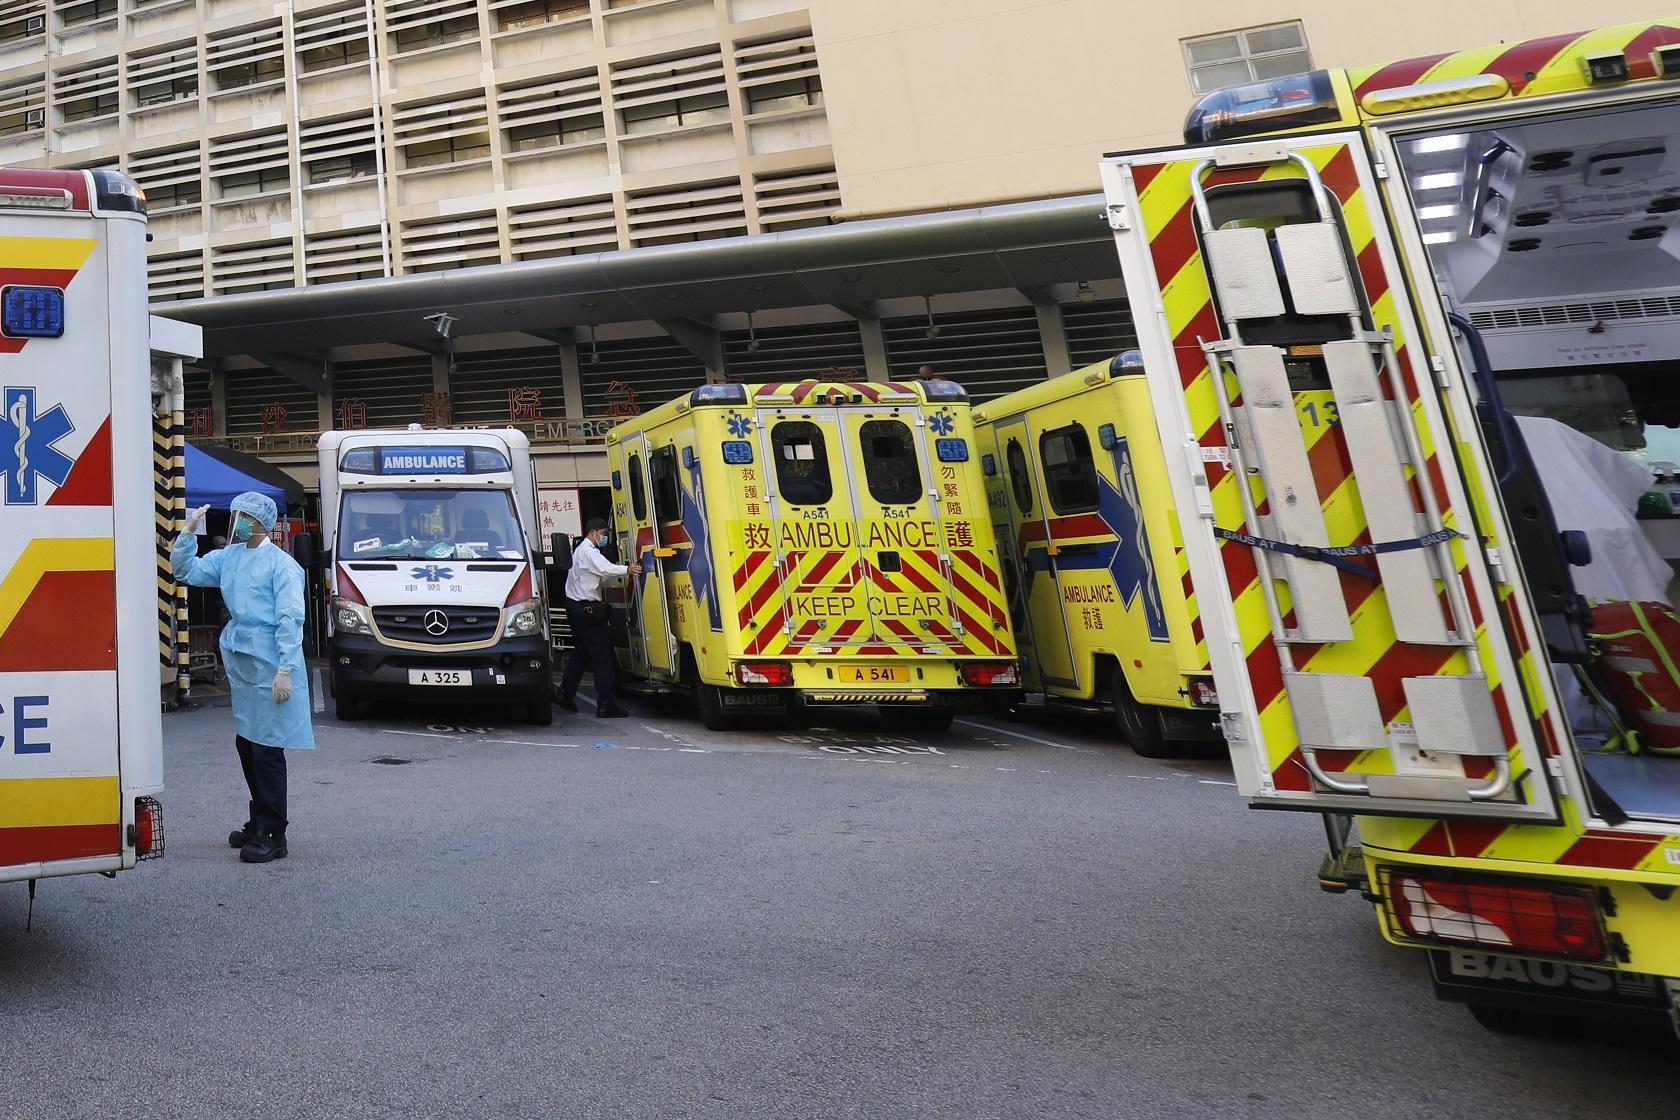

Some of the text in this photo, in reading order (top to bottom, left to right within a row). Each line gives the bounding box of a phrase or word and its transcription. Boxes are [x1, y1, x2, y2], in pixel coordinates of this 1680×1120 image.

[383, 455, 465, 469] AMBULANCE
[741, 467, 761, 517] 救護車
[941, 466, 962, 515] 勿緊隨
[803, 510, 830, 520] A541
[883, 510, 910, 519] A541
[744, 521, 975, 549] 救 AMBULANCE 護
[1223, 530, 1276, 550] BAUS AT
[1421, 531, 1448, 547] BAUS
[1361, 544, 1378, 555] AT
[1063, 584, 1115, 603] AMBULANCE
[797, 596, 945, 617] KEEP CLEAR
[1082, 607, 1104, 630] 救護
[421, 672, 460, 684] A 325
[855, 668, 894, 680] A 541
[724, 693, 768, 706] BAUS
[819, 745, 946, 756] ONLY
[1450, 949, 1614, 992] BAUS
